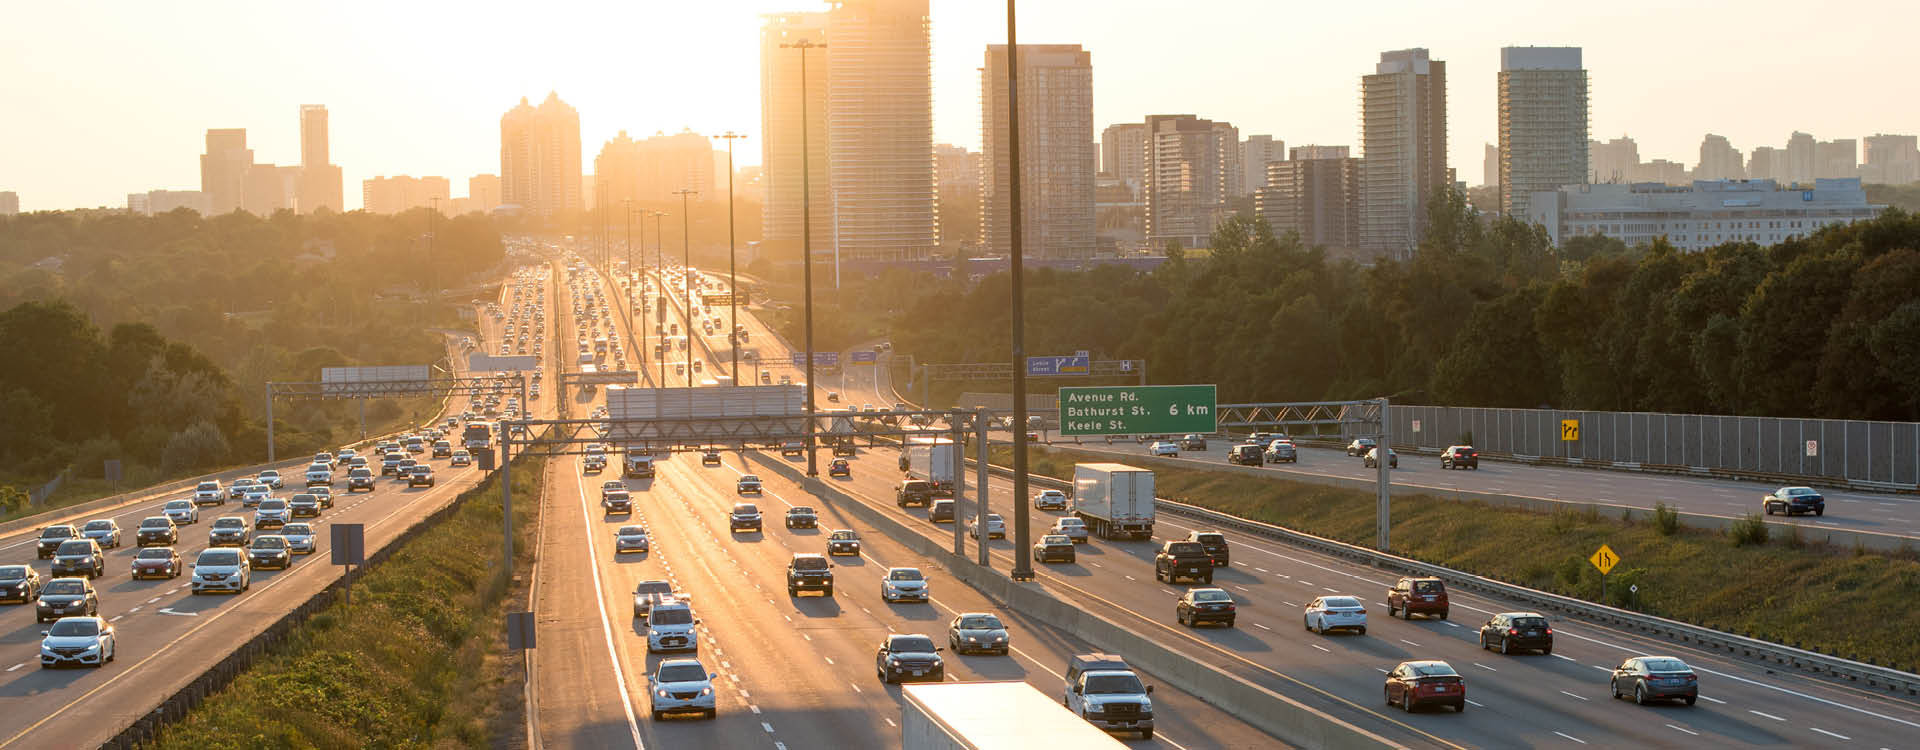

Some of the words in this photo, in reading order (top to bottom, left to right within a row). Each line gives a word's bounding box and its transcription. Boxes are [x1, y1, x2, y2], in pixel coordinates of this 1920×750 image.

[1122, 360, 1130, 370] H
[1068, 392, 1113, 402] Avenue
[1120, 392, 1139, 401] Rd.
[1068, 406, 1124, 416] Bathurst
[1131, 406, 1150, 415] St.
[1169, 404, 1178, 415] 6
[1187, 404, 1209, 415] km
[1068, 420, 1102, 430] Keele
[1109, 420, 1127, 430] St.
